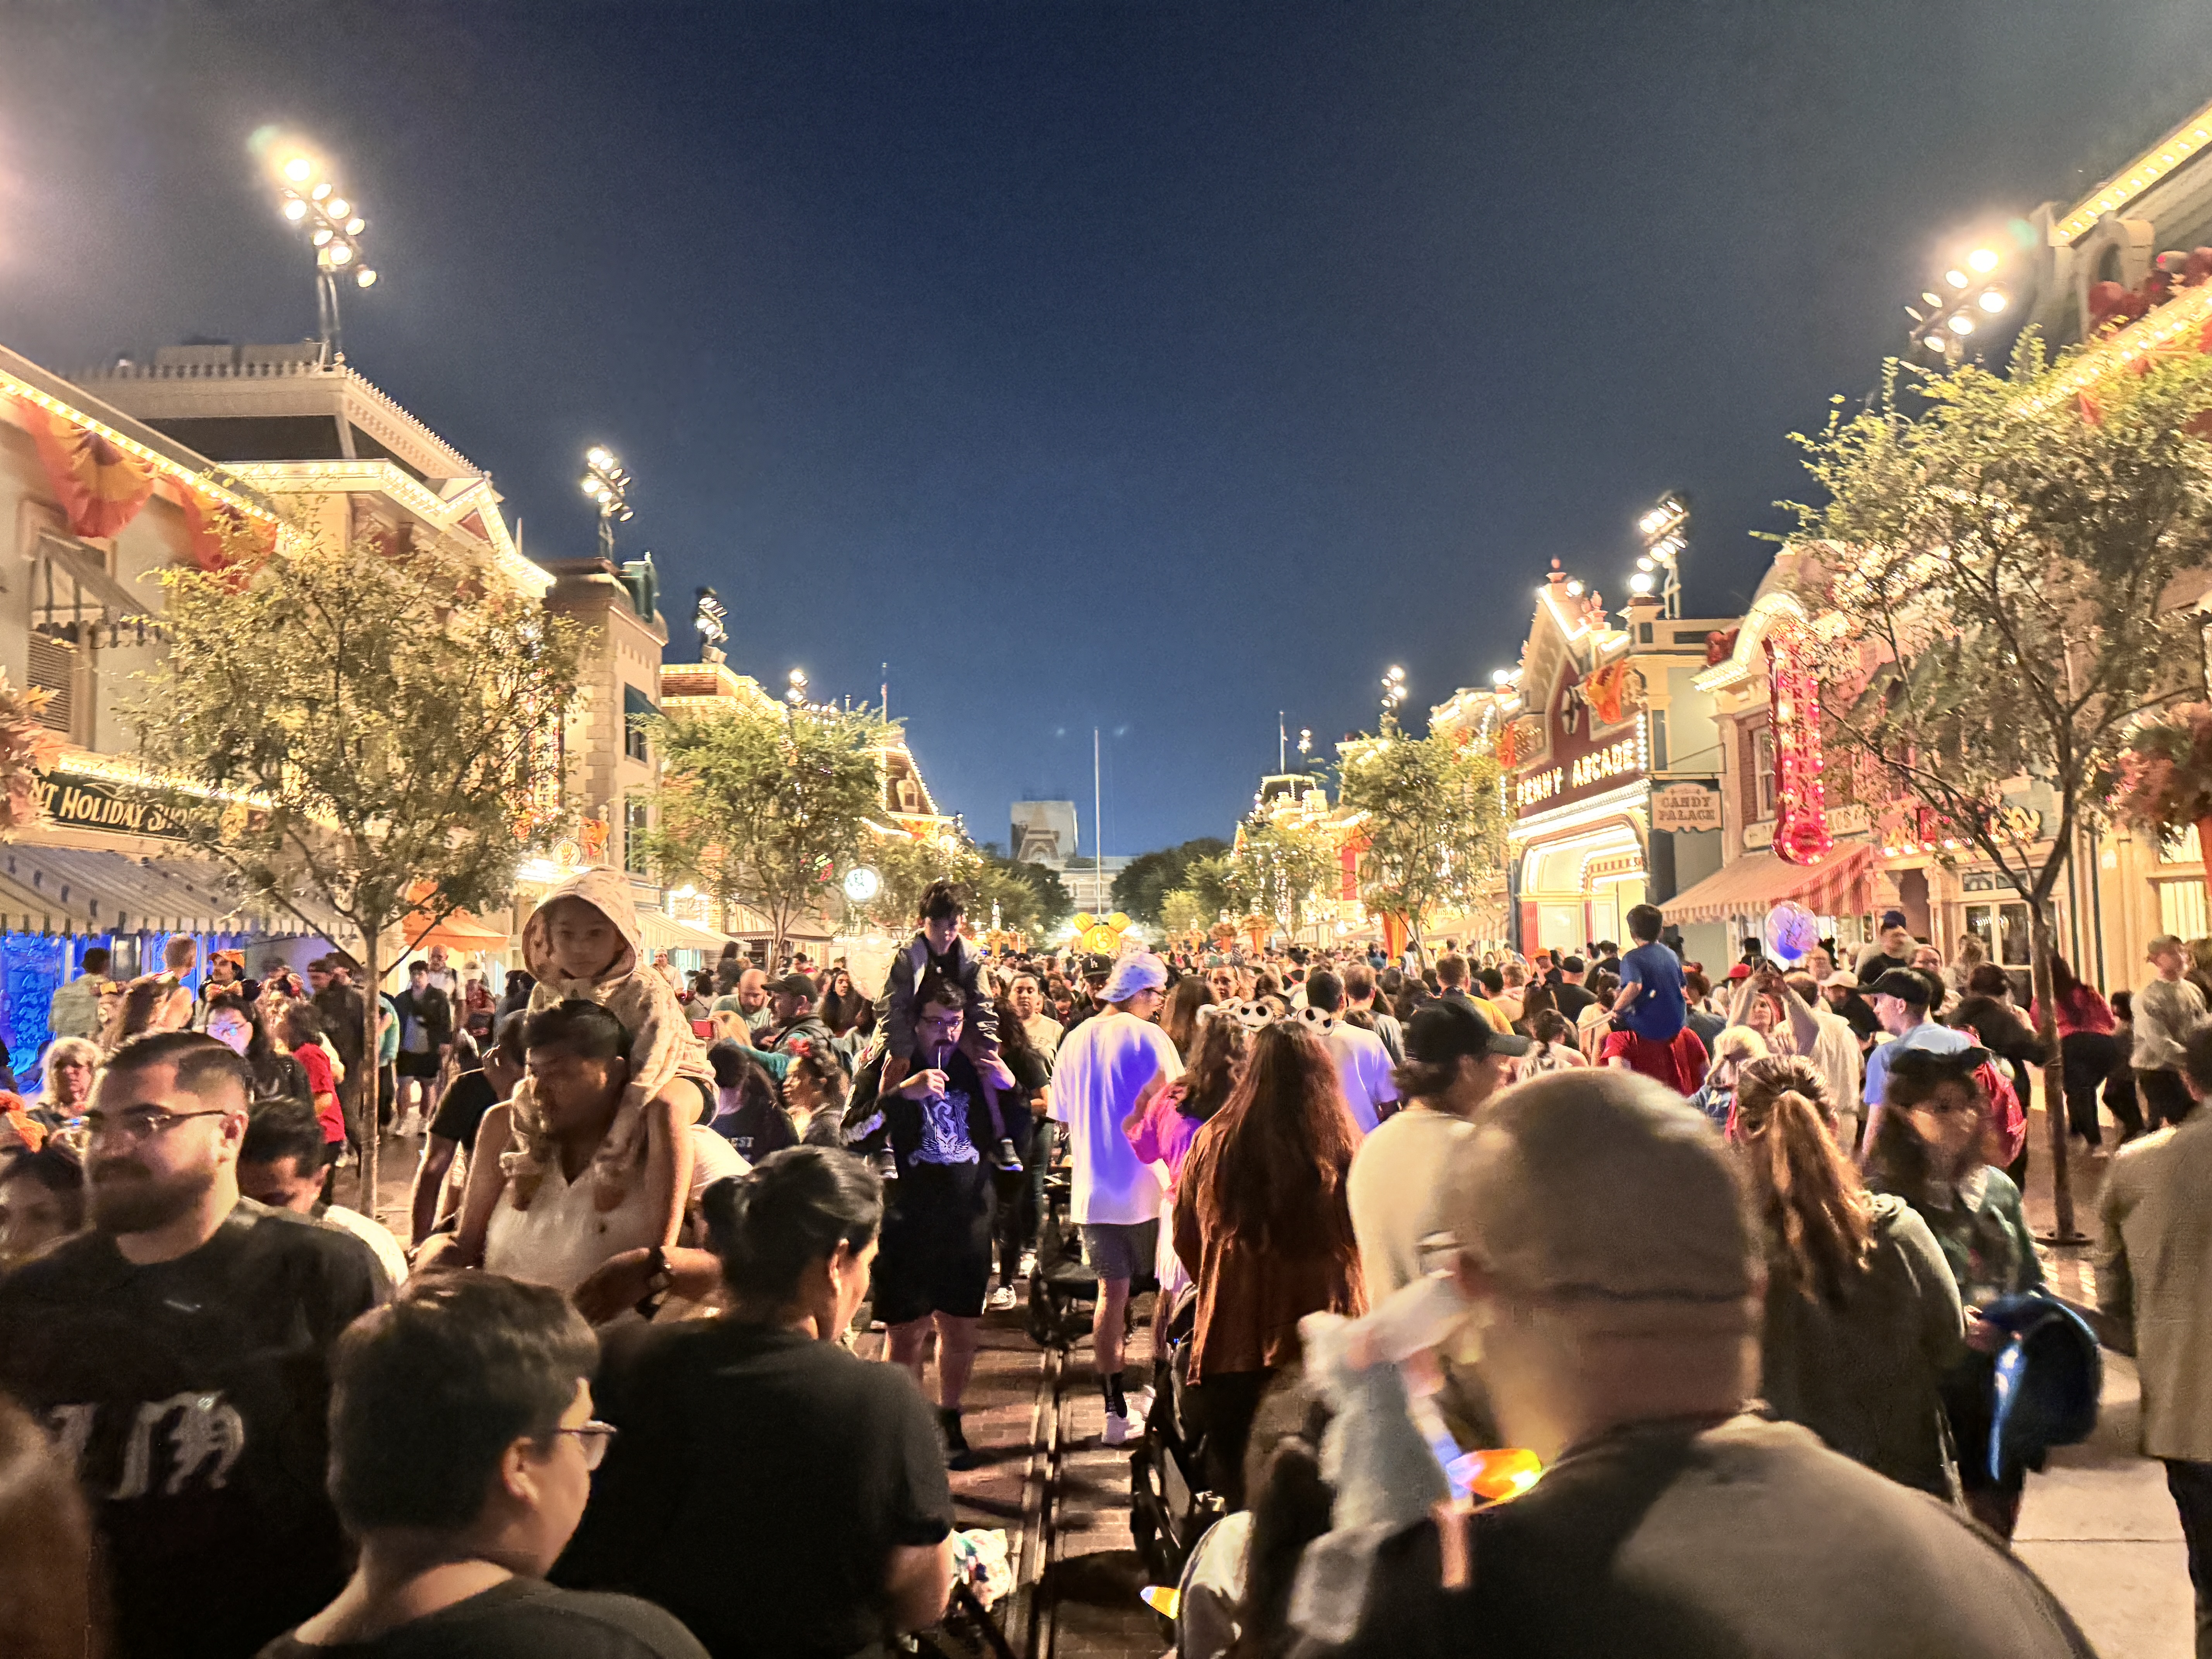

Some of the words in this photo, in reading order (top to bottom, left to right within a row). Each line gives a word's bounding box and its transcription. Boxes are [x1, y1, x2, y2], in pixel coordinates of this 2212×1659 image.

[1516, 766, 1562, 807] PENNY
[1572, 738, 1635, 788] ARCADE
[59, 786, 148, 828] HOLIDAY
[1661, 796, 1711, 807] CANDY
[1658, 809, 1715, 820] PALACE
[1090, 958, 1098, 968] LA
